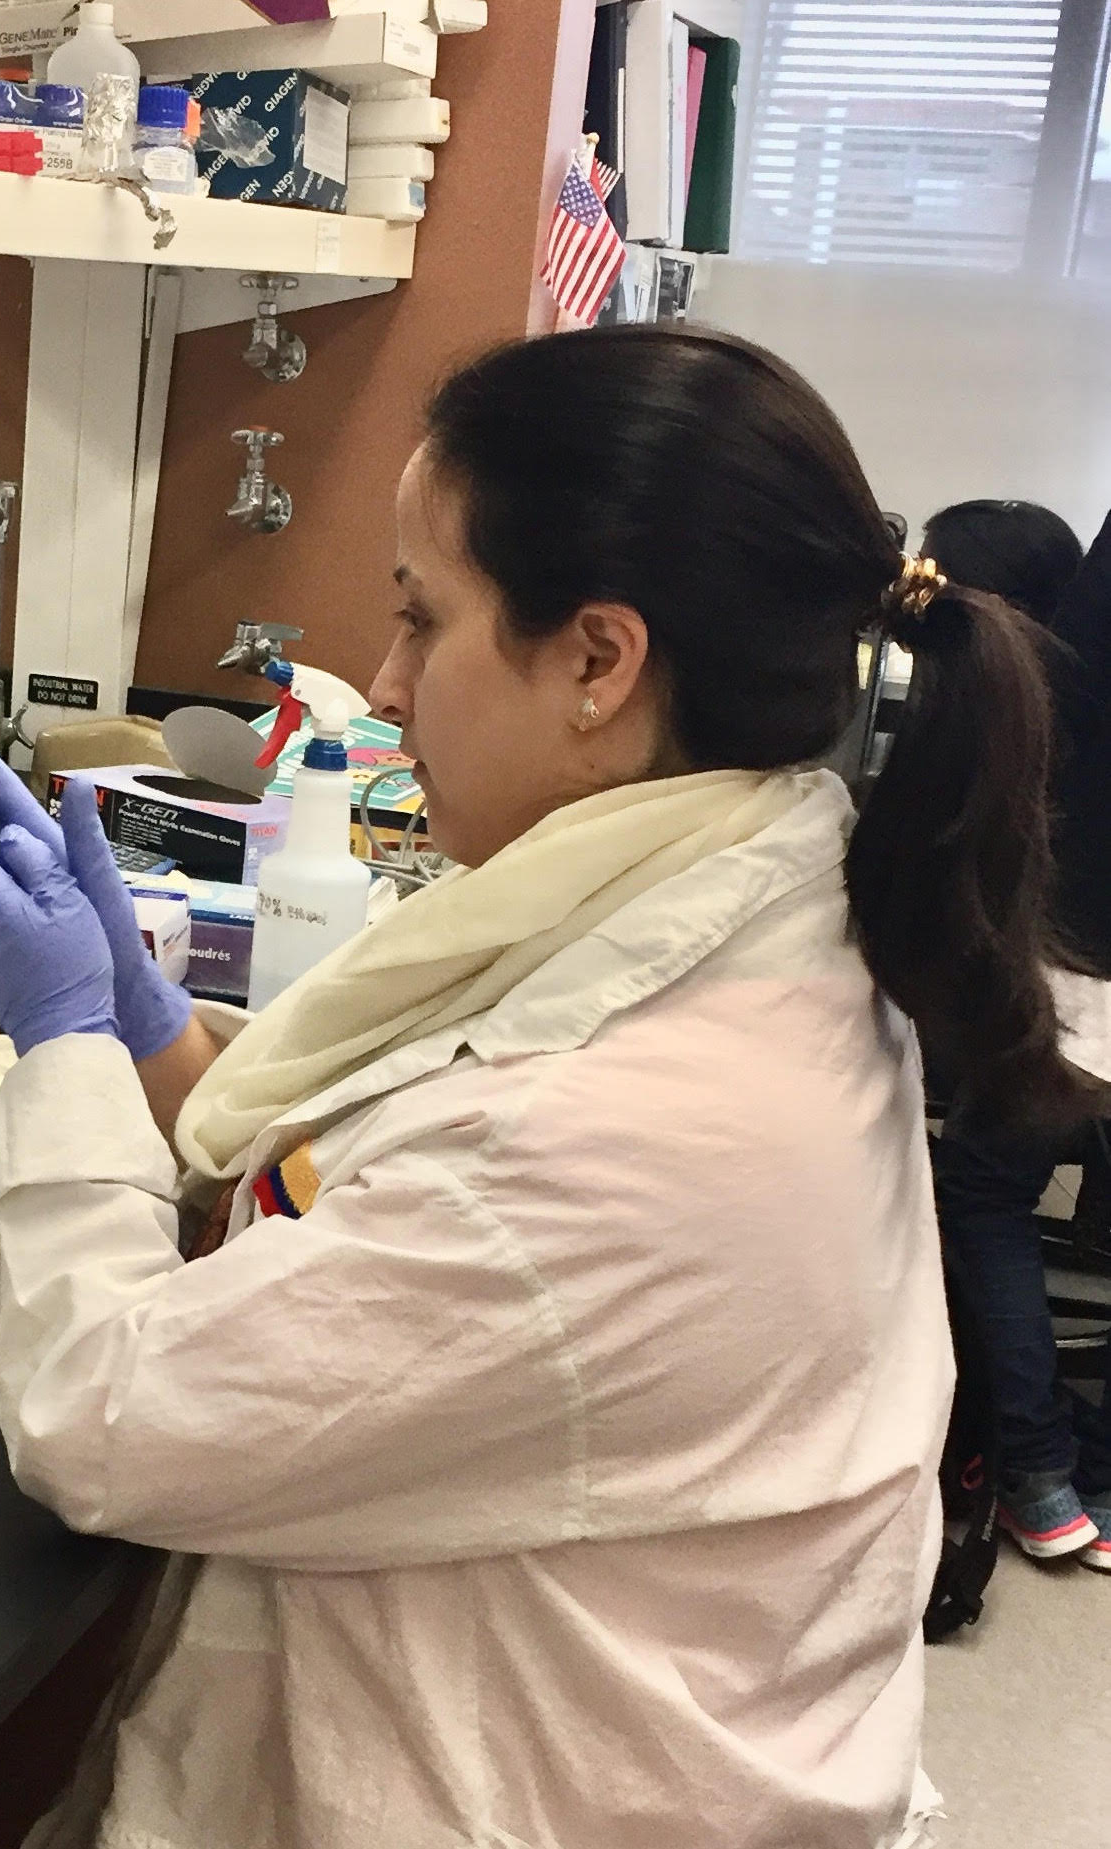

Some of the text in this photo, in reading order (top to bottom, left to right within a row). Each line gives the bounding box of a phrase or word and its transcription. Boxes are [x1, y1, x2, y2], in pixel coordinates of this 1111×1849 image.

[264, 72, 299, 113] QIAGEN
[32, 678, 95, 694] INDUSTRIAL WATER
[37, 690, 88, 705] DO NOT DRINK
[119, 797, 179, 821] X-GEN
[189, 947, 232, 962] oudrés
